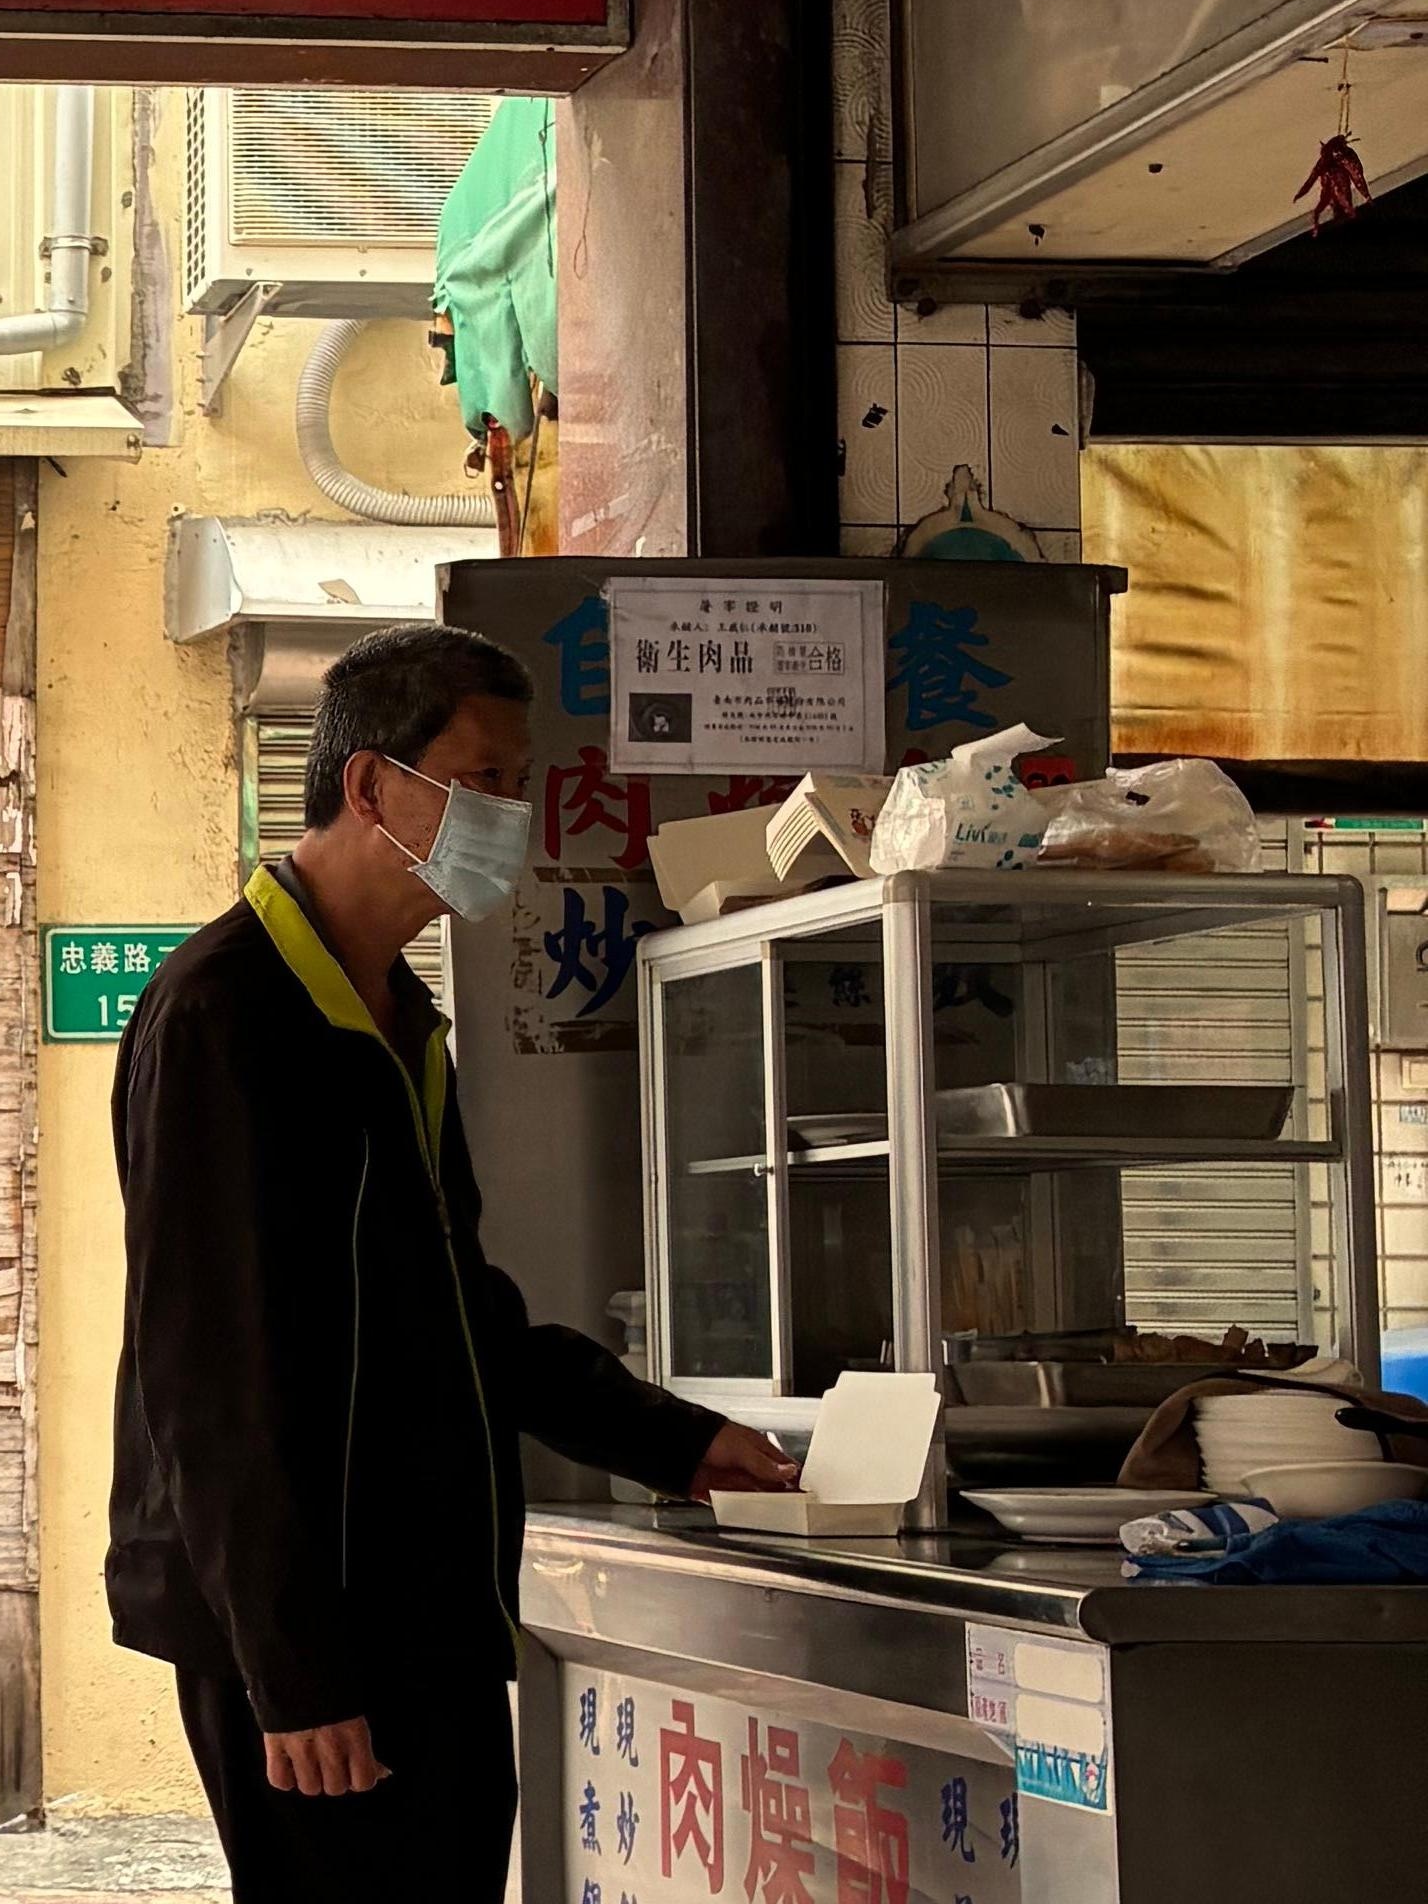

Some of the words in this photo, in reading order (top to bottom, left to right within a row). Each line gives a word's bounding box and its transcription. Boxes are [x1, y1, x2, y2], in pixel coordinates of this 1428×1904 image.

[543, 596, 1014, 732] 自餐
[636, 639, 753, 674] 衛生肉品
[808, 647, 842, 673] 合格
